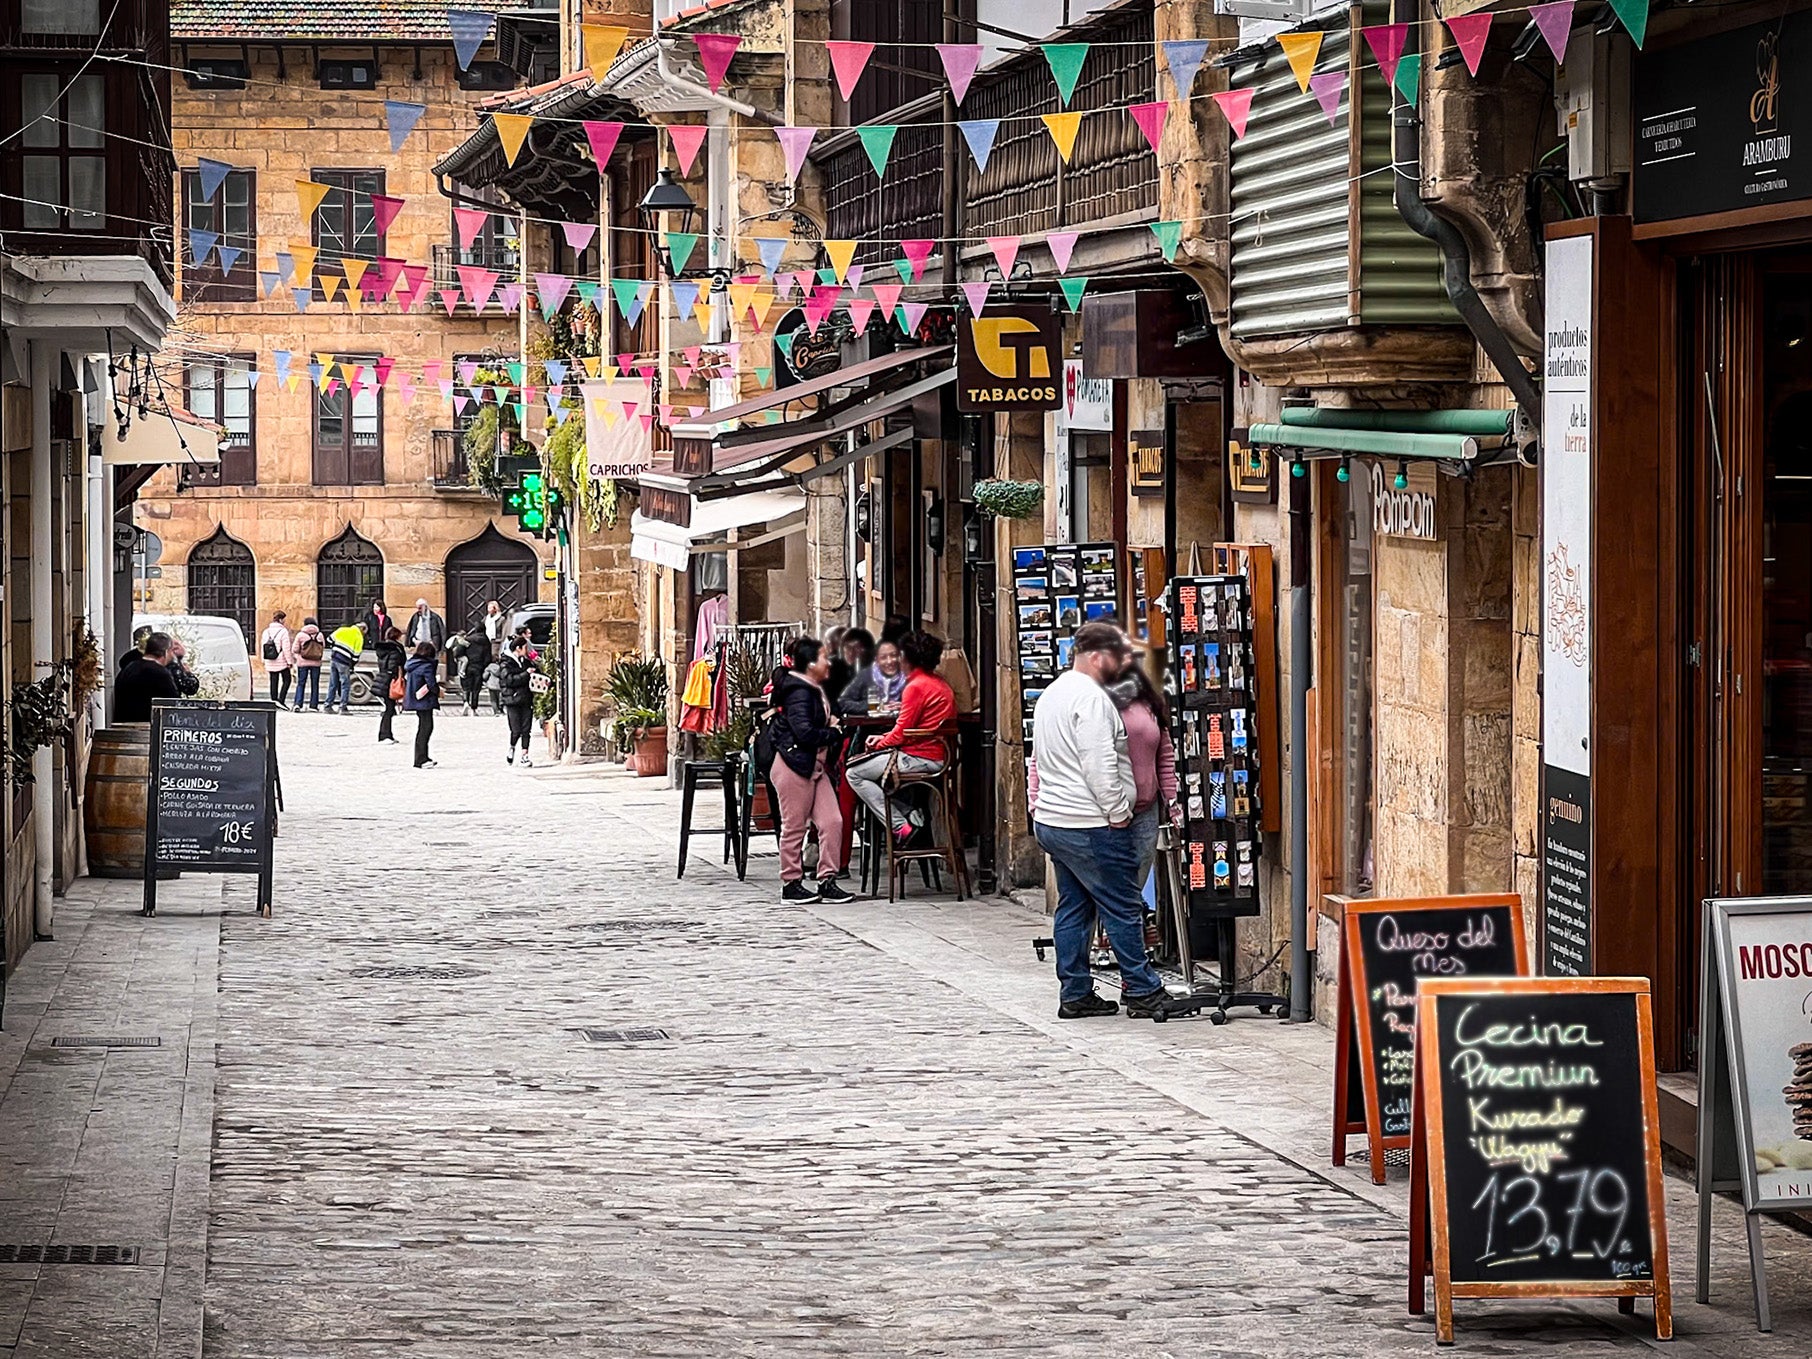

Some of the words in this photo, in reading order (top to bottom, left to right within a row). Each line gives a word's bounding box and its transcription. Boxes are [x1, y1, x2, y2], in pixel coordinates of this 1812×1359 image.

[1743, 135, 1791, 166] ARAMBURU
[1548, 320, 1587, 357] productos
[1547, 350, 1587, 377] auténticos
[967, 387, 1057, 402] TABACOS
[1570, 403, 1579, 428] de
[1580, 403, 1586, 428] la
[1565, 426, 1586, 452] tierra
[590, 463, 649, 476] CAPRICHOS
[1372, 462, 1434, 538] Pompom
[160, 776, 220, 790] SEGUNDOS
[163, 792, 186, 800] POLLO
[1549, 793, 1583, 825] genuino
[219, 821, 255, 843] 18€
[1377, 914, 1450, 951] Queso
[1457, 913, 1496, 948] del
[1455, 1002, 1604, 1046] Cecina
[1451, 1049, 1600, 1089] Premiun
[1469, 1097, 1584, 1132] Kurado
[1472, 1168, 1628, 1262] 13,79
